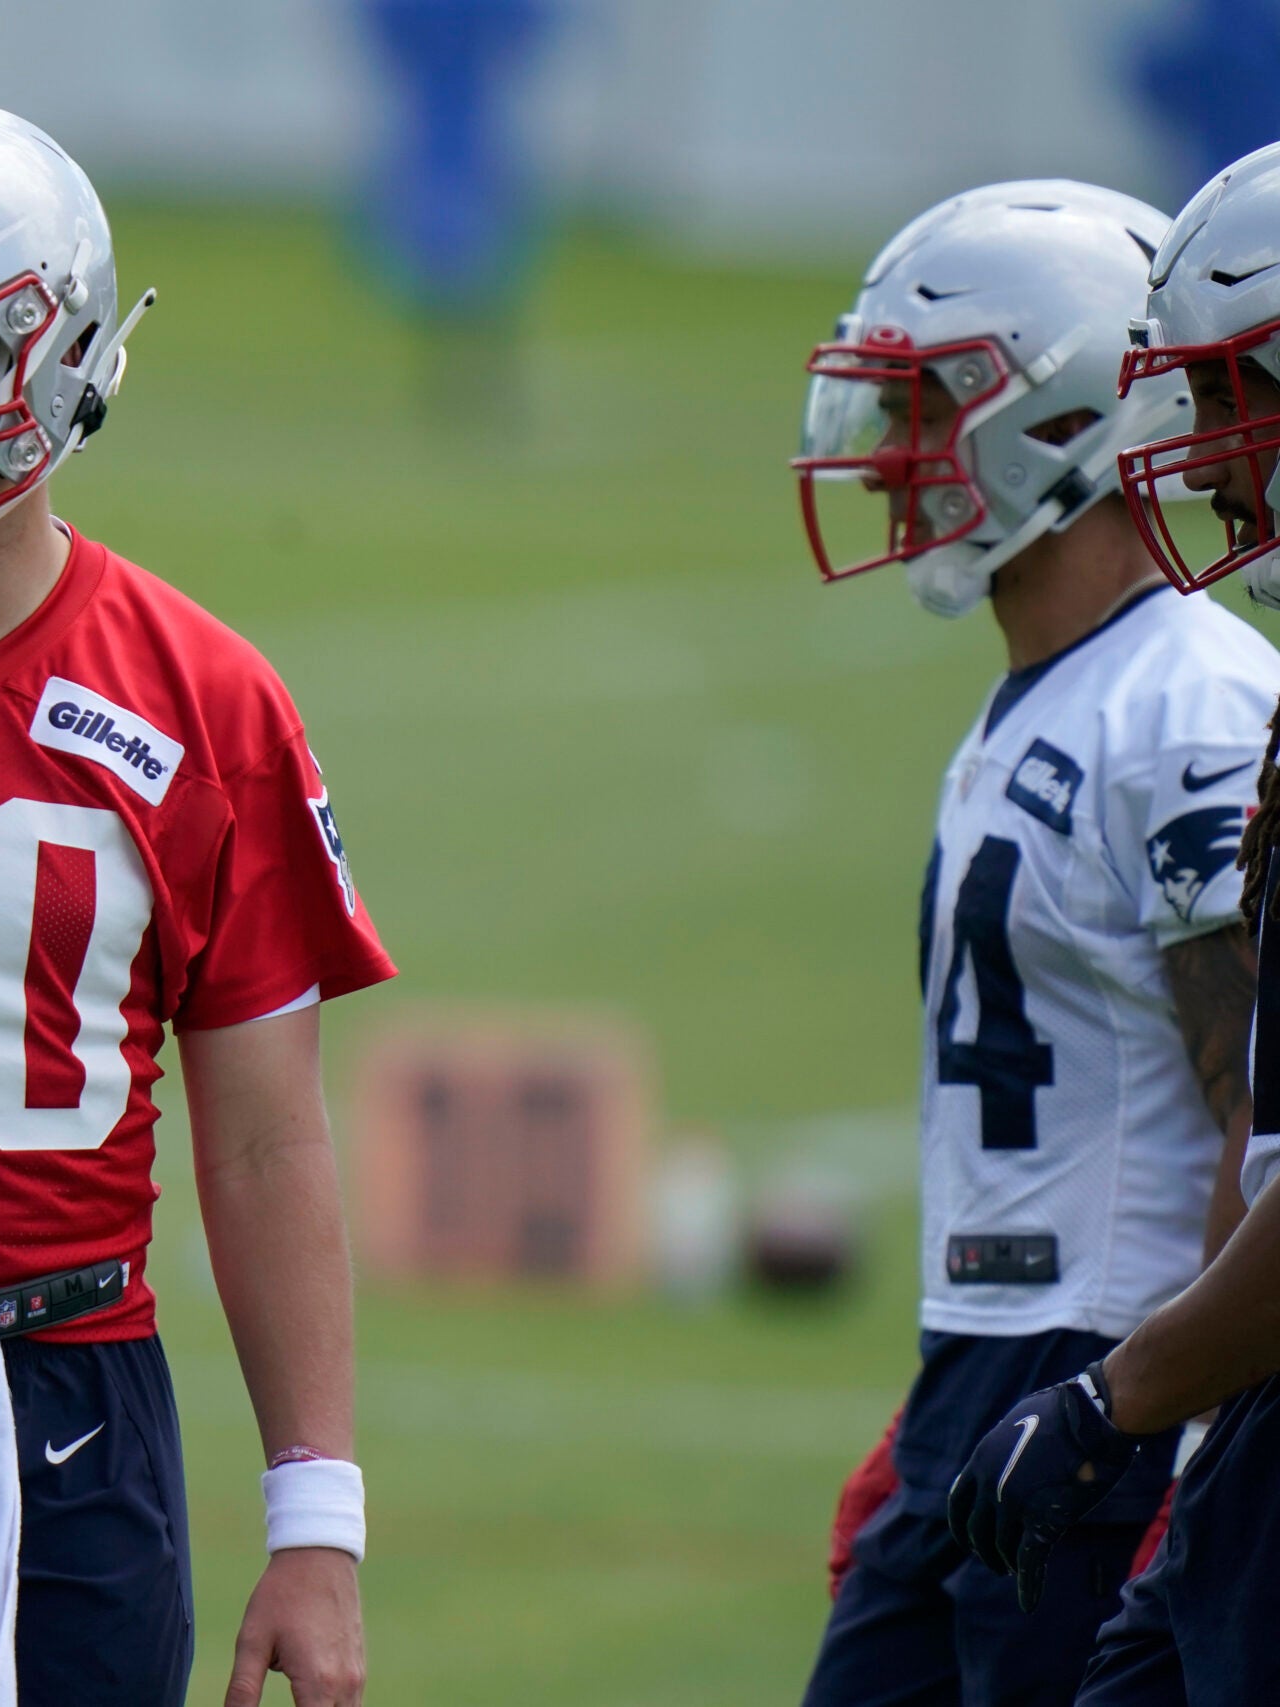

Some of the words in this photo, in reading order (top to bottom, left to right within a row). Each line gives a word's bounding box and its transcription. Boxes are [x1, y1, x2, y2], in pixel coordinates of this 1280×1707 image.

[48, 701, 163, 780] Gillette
[64, 1274, 84, 1297] M
[0, 1311, 14, 1326] NFL
